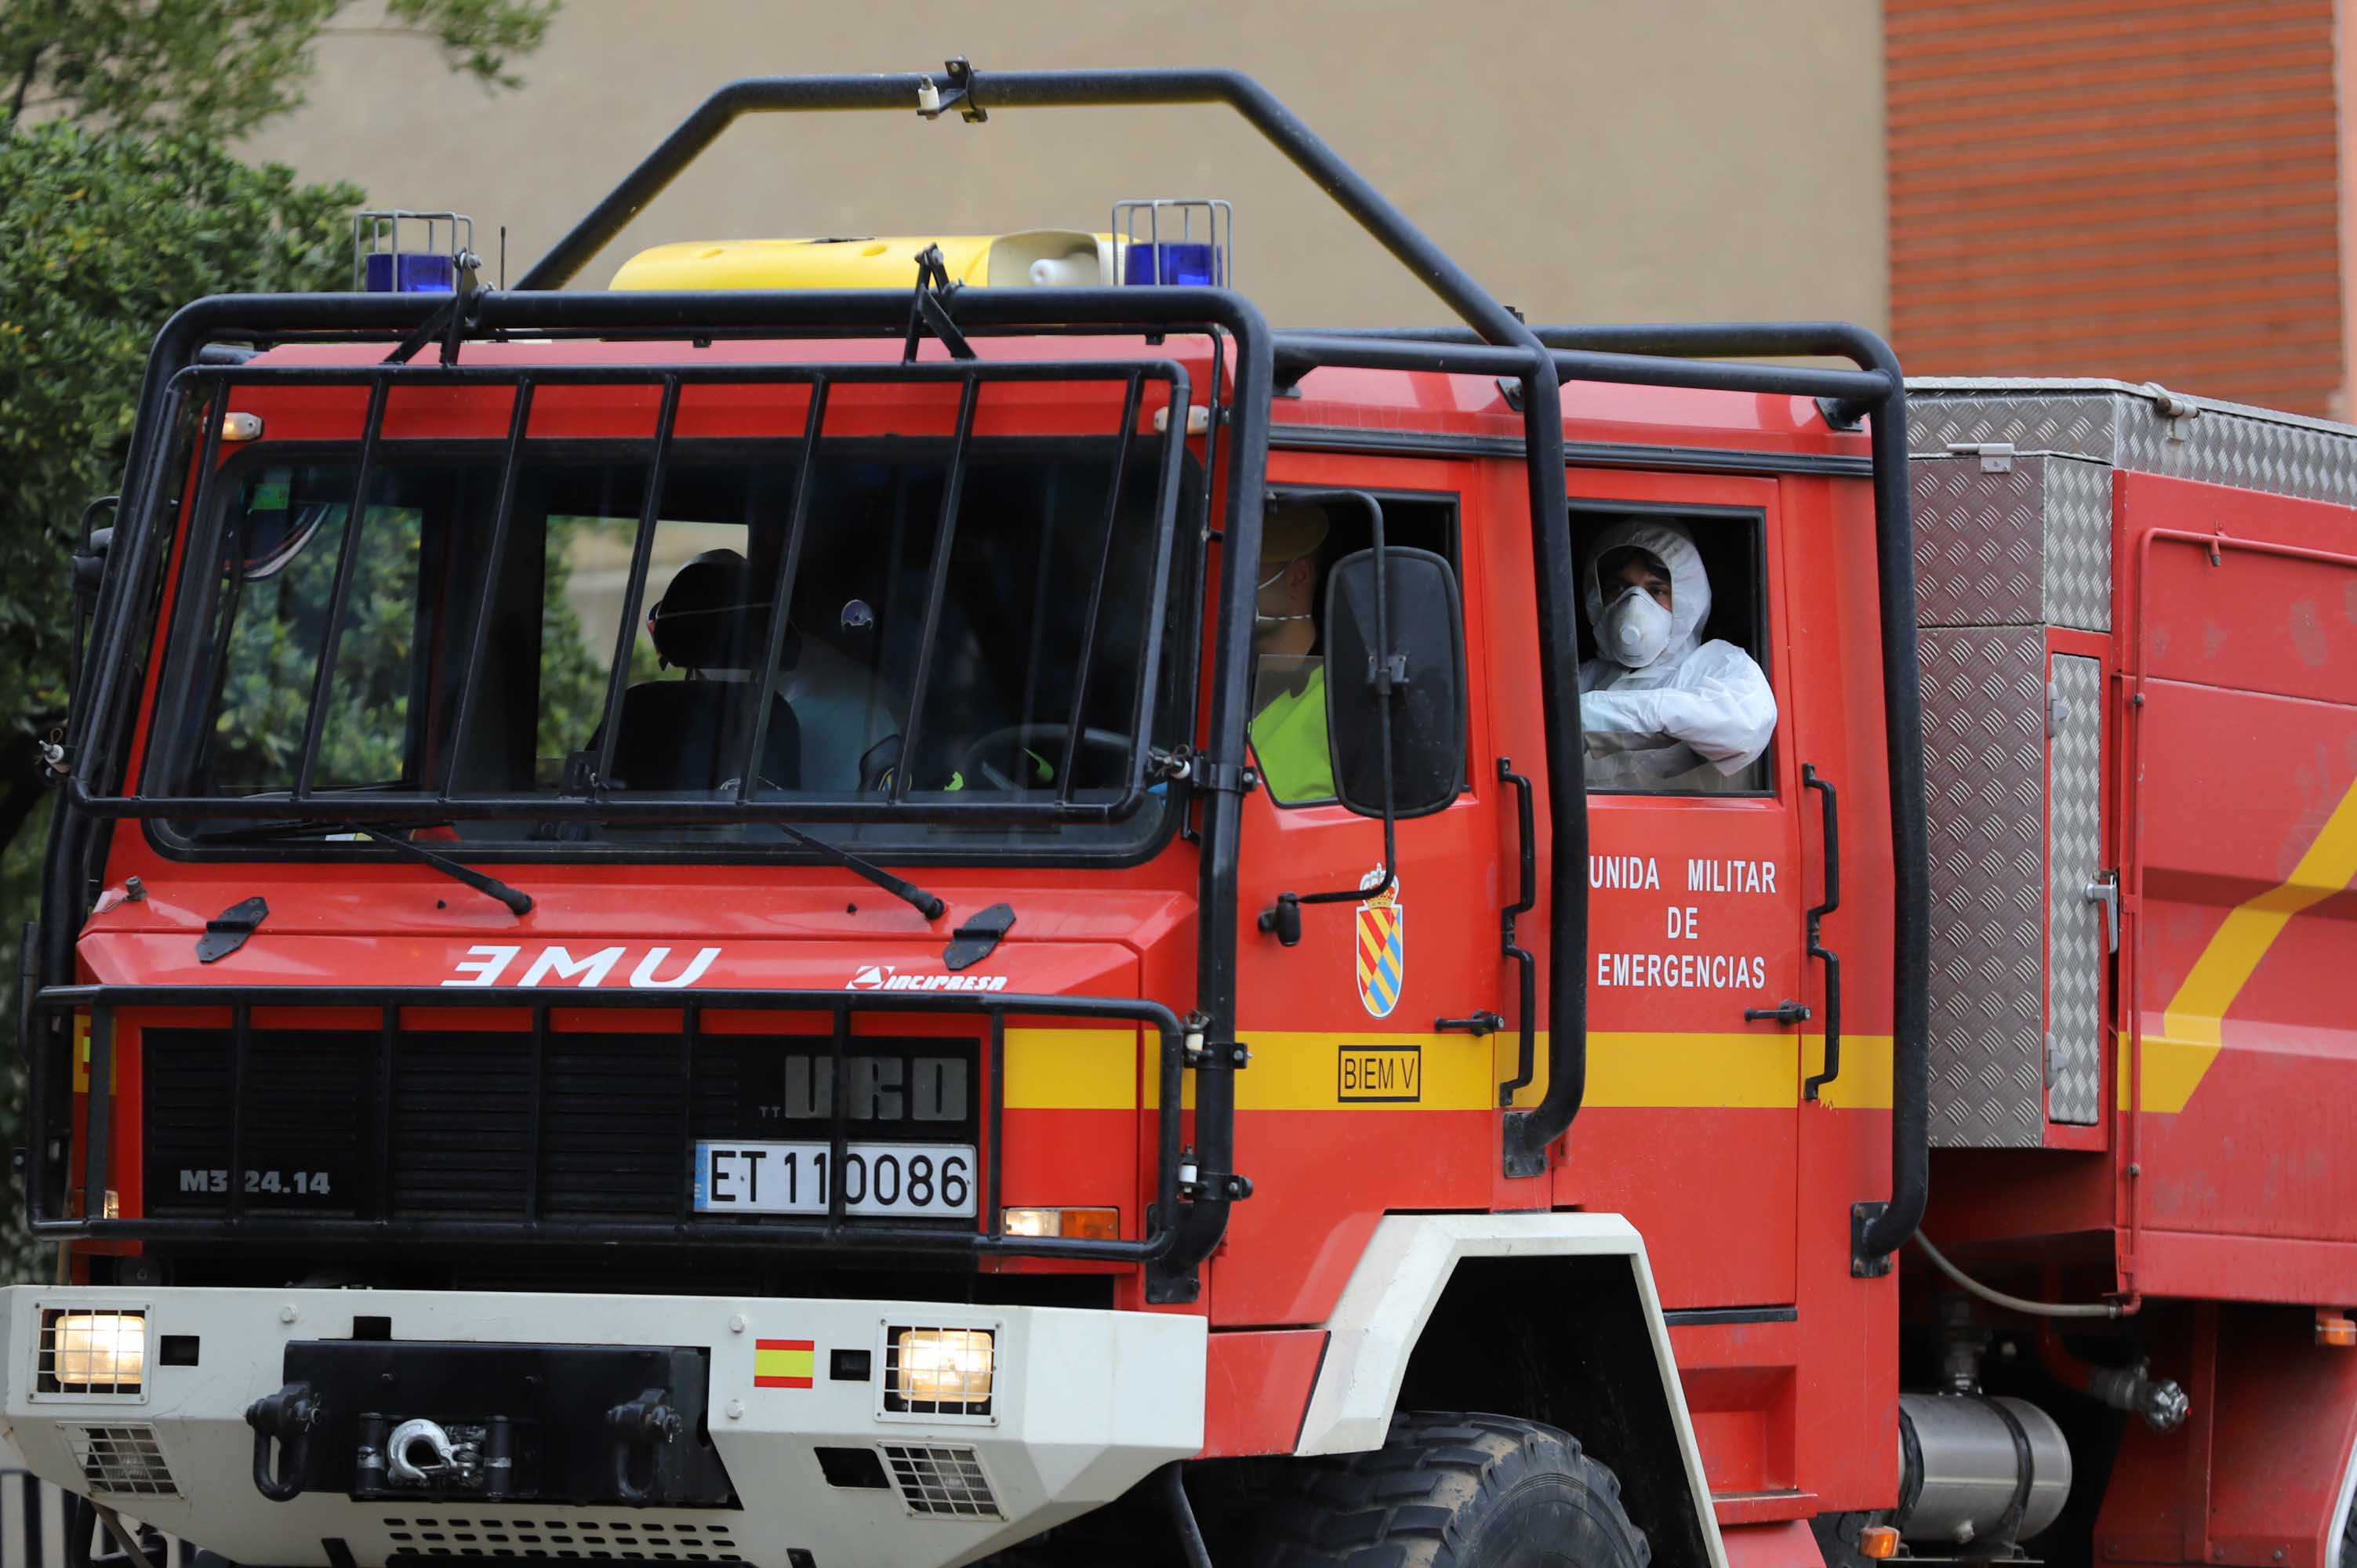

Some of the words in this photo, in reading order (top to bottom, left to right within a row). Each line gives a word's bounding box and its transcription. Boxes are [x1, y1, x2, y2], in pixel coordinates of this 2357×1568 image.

[1589, 855, 1661, 891] UNIDA
[1687, 858, 1777, 894] MILITAR
[1667, 906, 1698, 939] DE
[1597, 953, 1766, 990] EMERGENCIAS
[1343, 1058, 1394, 1090] BIEM
[1400, 1058, 1415, 1090] V
[180, 1169, 228, 1192] M3
[244, 1170, 331, 1195] 24.14
[710, 1150, 767, 1203] ET
[784, 1152, 968, 1207] 110086
